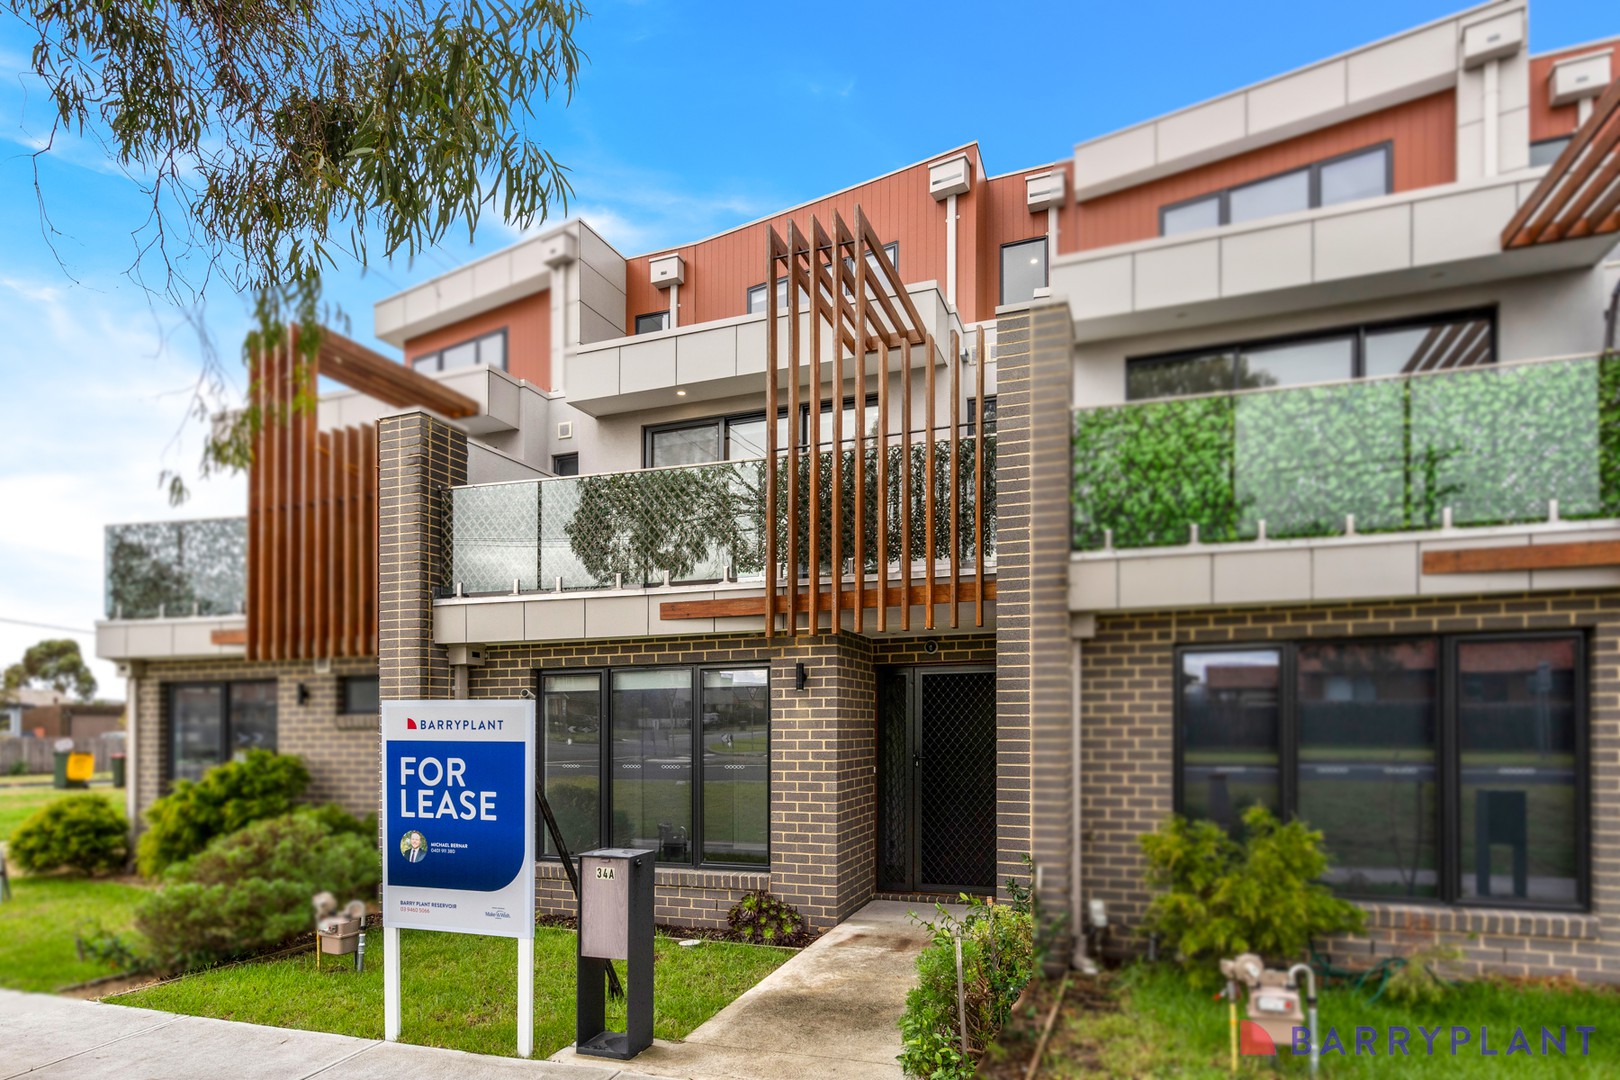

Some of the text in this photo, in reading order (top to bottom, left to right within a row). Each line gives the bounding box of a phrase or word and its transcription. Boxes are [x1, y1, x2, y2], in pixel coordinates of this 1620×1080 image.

[420, 719, 504, 730] BARRYPLANT
[400, 756, 466, 787] FOR
[400, 789, 497, 821] LEASE
[596, 867, 615, 880] 34A
